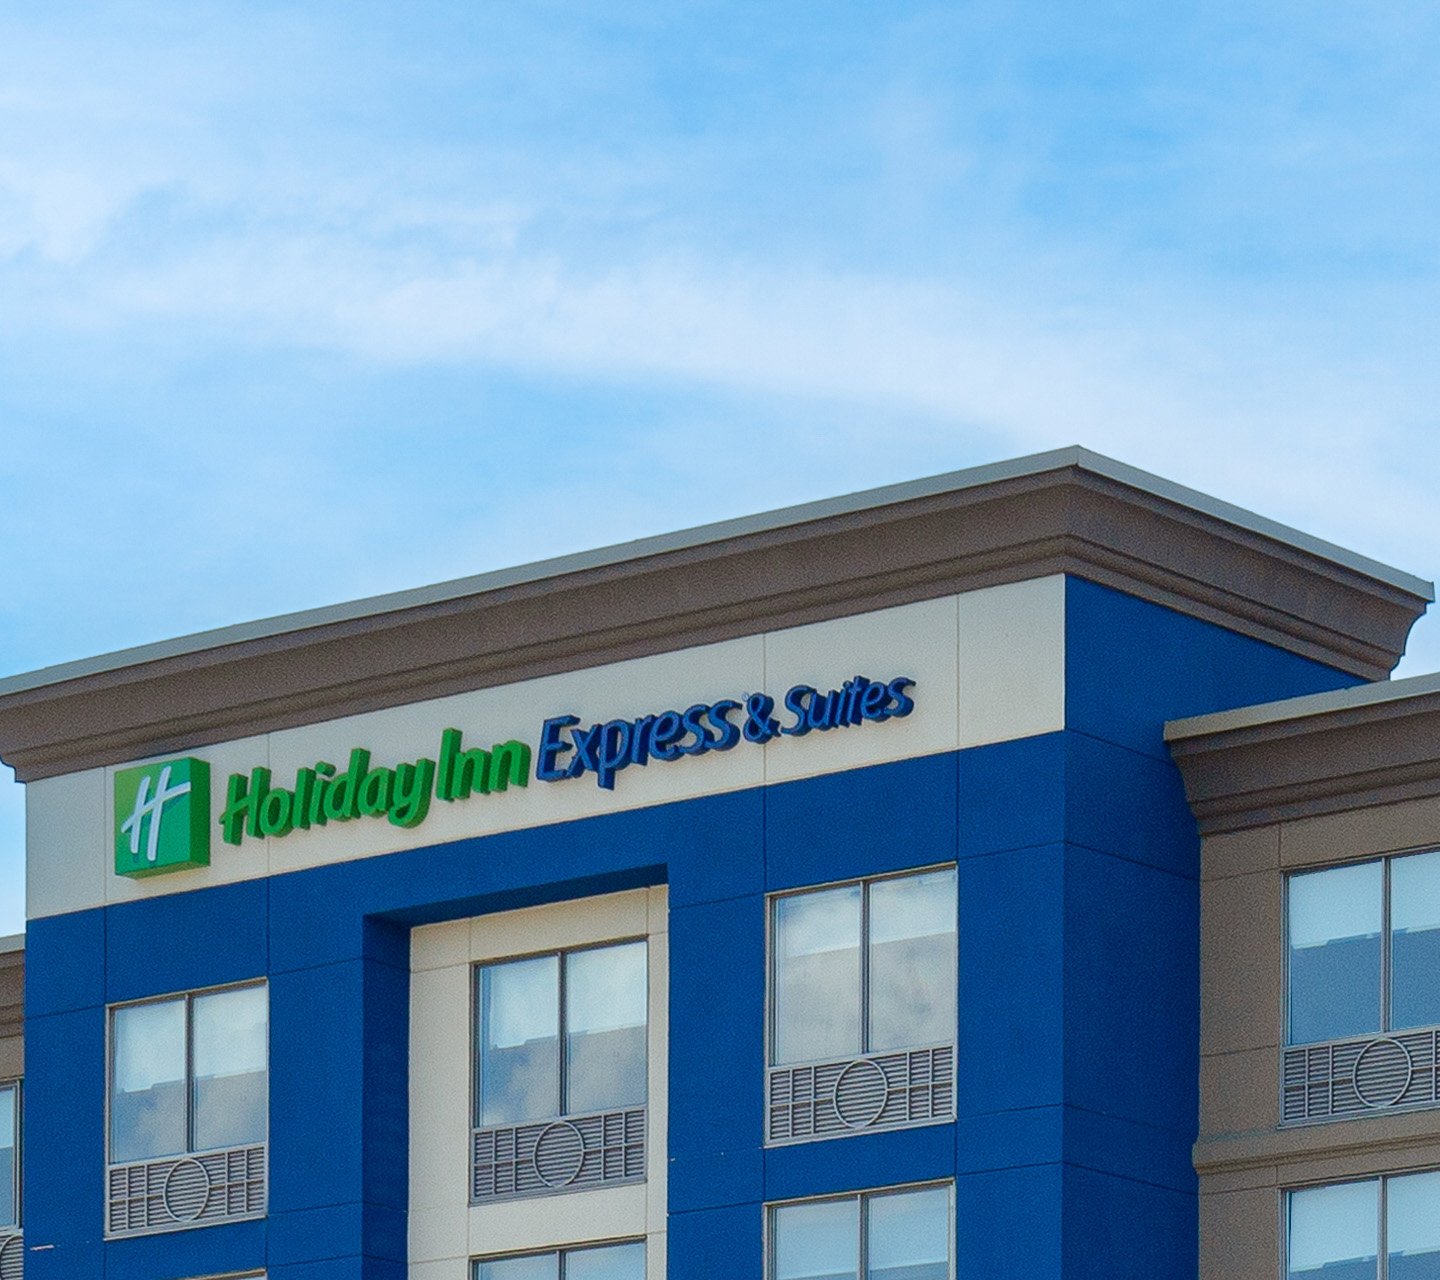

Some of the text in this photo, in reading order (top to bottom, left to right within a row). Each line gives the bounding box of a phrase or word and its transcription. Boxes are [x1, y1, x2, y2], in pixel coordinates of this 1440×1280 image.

[219, 675, 916, 846] Holiday Inn Express & Suites
